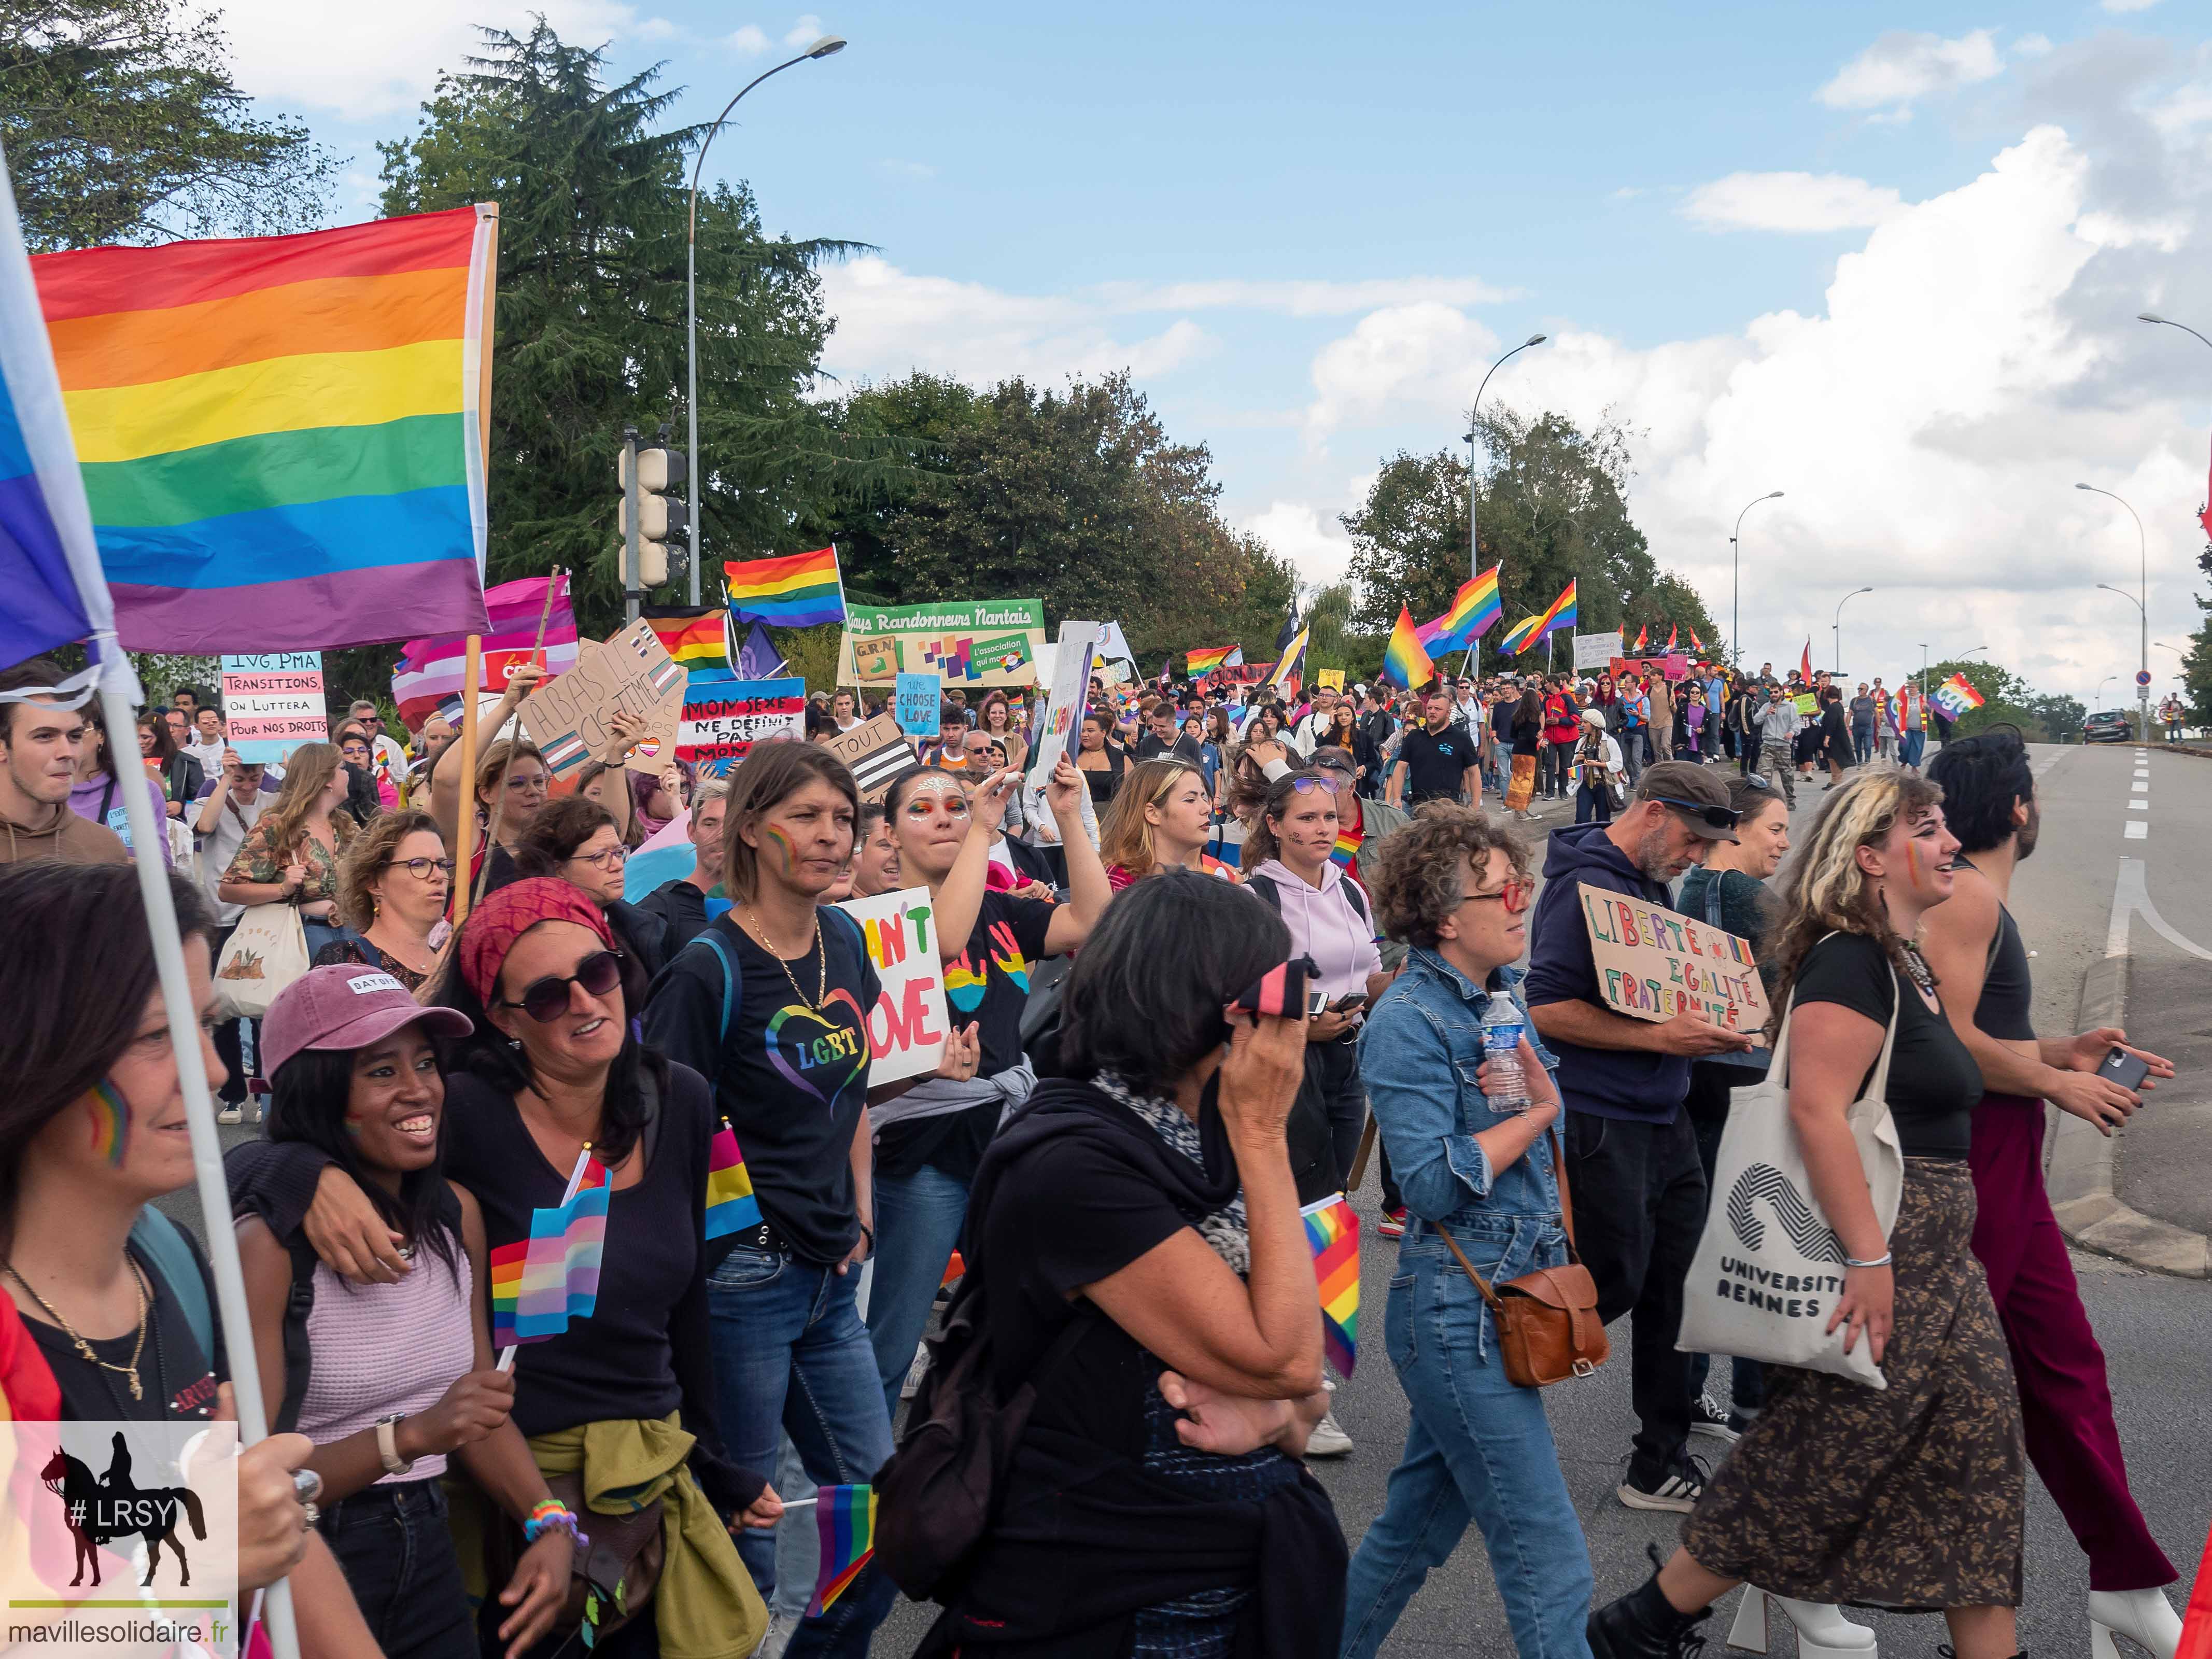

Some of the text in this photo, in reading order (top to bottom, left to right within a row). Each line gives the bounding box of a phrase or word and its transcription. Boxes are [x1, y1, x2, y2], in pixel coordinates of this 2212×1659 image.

[848, 606, 1033, 634] Gays Randonneurs Nantais
[857, 640, 894, 657] G.R.N.
[975, 640, 1021, 656] L'association
[976, 657, 988, 668] qui
[224, 676, 320, 690] TRANSITIONS,
[545, 666, 605, 726] BAS
[601, 639, 638, 684] LE
[230, 699, 310, 711] ON LUTTERA
[686, 698, 738, 721] MON
[746, 696, 790, 713] SEXE
[899, 694, 935, 707] CHOOSE
[905, 708, 932, 723] LOVE
[231, 721, 327, 736] POUR NOS DROITS
[695, 721, 721, 733] NE
[716, 731, 754, 745] PAS
[833, 722, 882, 760] TOUT
[695, 746, 748, 762] MON
[1585, 894, 1703, 956] LIBERTÉ
[856, 901, 932, 969] AN'T
[353, 979, 378, 989] DAY
[1666, 957, 1759, 1008] EGALITÉ
[866, 977, 941, 1060] OVE
[795, 1027, 858, 1070] LGBT
[1720, 1256, 1846, 1296] UNIVERSIT
[1716, 1279, 1820, 1317] RENNES
